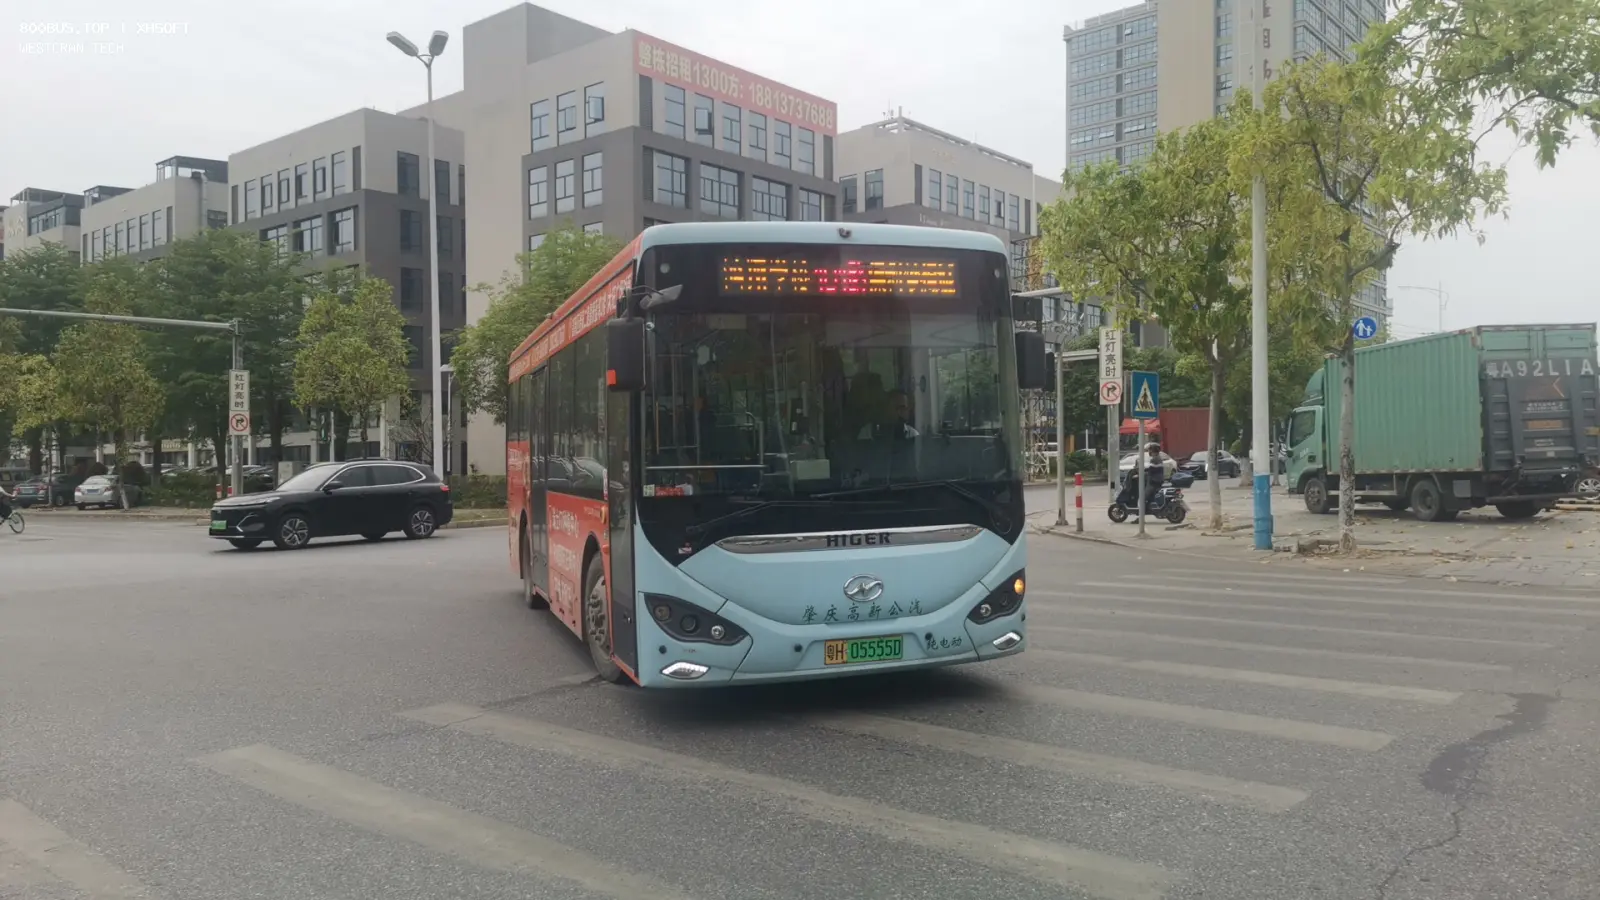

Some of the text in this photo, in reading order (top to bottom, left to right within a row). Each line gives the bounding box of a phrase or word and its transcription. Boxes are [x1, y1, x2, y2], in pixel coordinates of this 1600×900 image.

[1105, 330, 1116, 377] 红灯亮时
[234, 374, 244, 408] 红灯亮时
[826, 532, 892, 548] HIGER
[802, 600, 924, 624] 肇庆高新公汽
[926, 636, 963, 651] 纯电动
